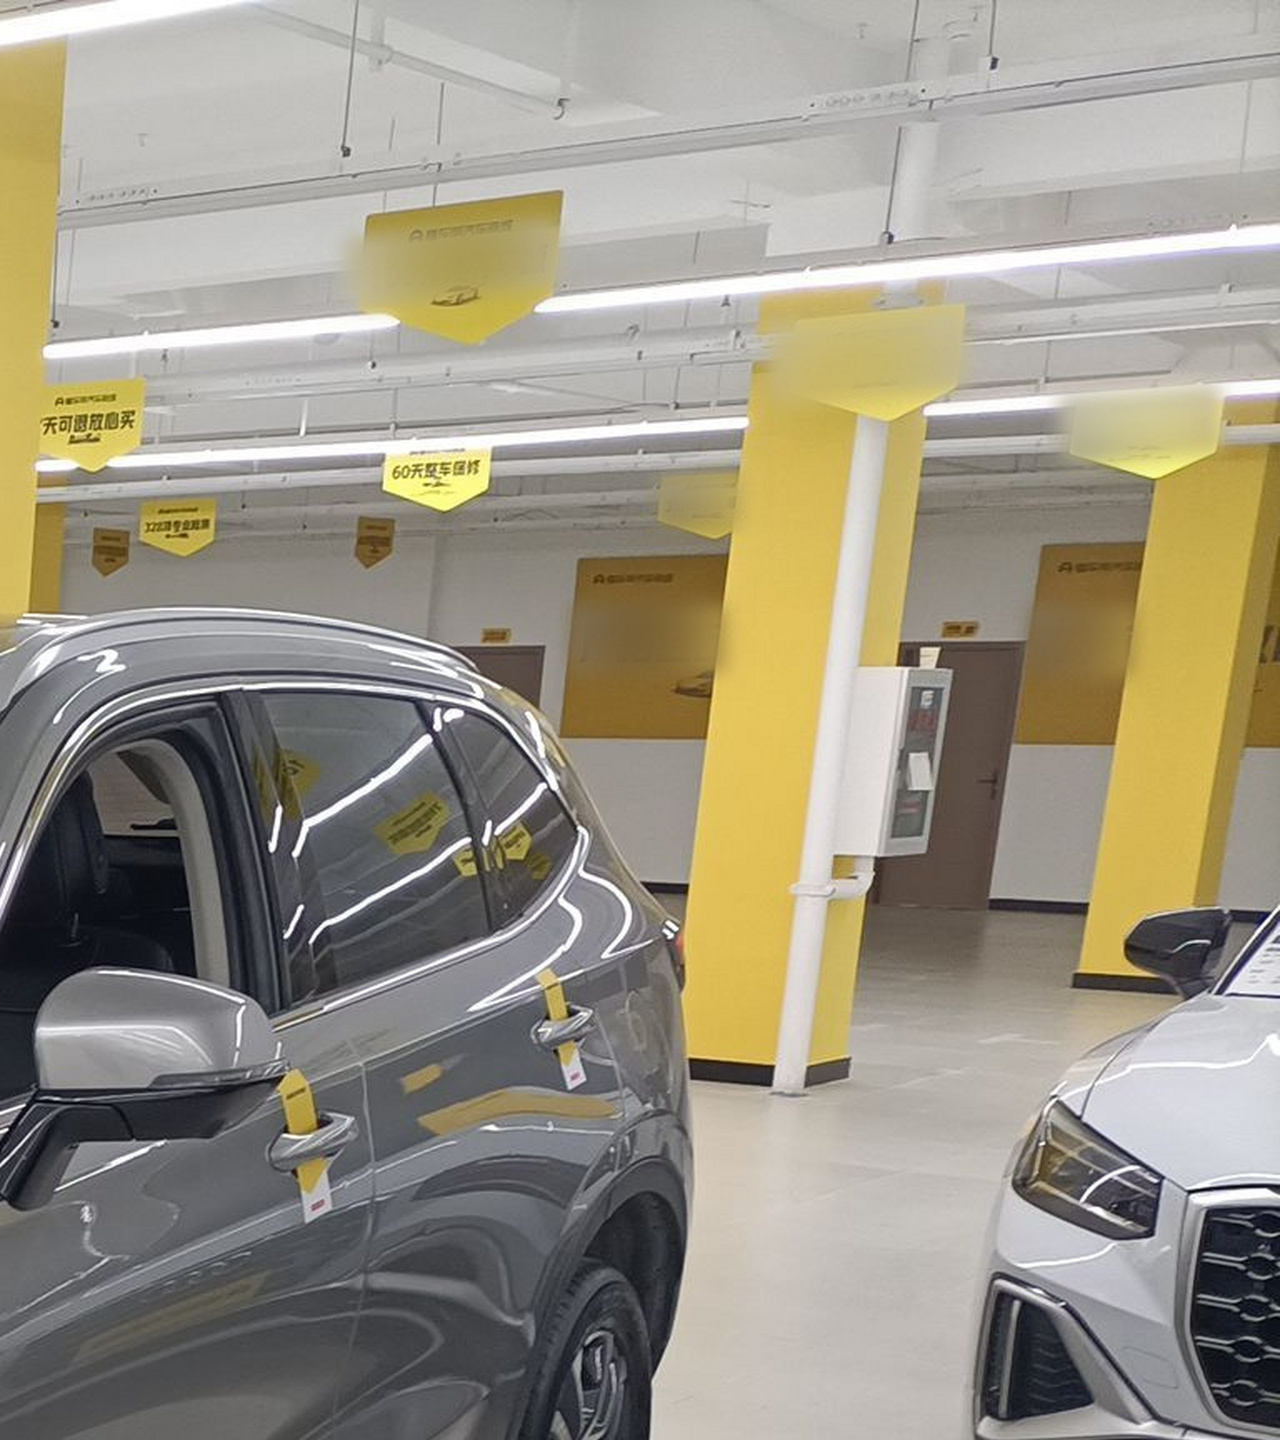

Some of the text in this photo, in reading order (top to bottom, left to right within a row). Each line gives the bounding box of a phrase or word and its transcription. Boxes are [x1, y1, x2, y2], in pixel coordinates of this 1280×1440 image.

[392, 459, 481, 480] 60天整车保修
